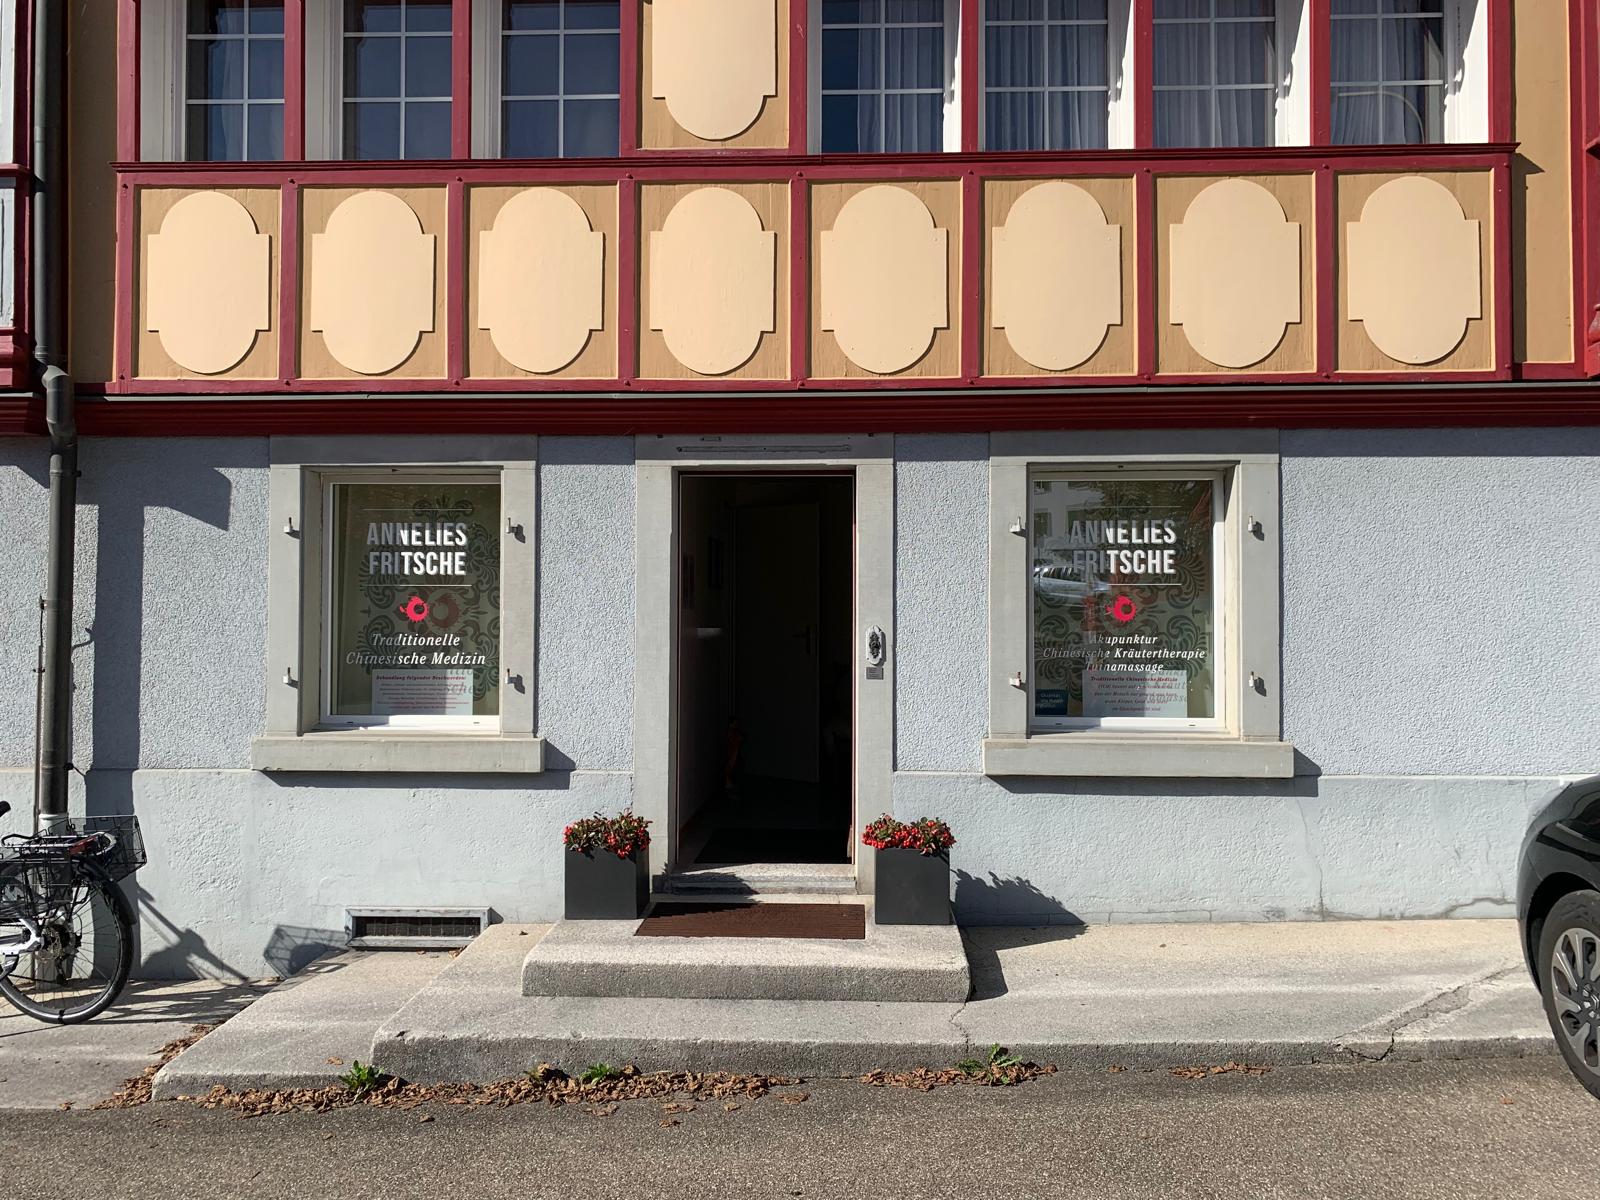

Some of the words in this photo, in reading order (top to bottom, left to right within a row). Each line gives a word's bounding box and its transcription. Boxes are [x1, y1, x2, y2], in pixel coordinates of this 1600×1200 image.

[367, 523, 467, 546] ANNELIES
[1070, 520, 1177, 544] ANNELIES
[369, 552, 466, 575] FRITSCHE
[1073, 550, 1176, 574] FRITSCHE
[372, 633, 460, 646] Traditionelle
[1089, 634, 1158, 647] Akupunktur
[346, 652, 426, 665] Chinesische
[431, 652, 486, 665] Medizin
[1043, 648, 1110, 659] Chinesische
[1114, 648, 1206, 660] Kräutertherapie
